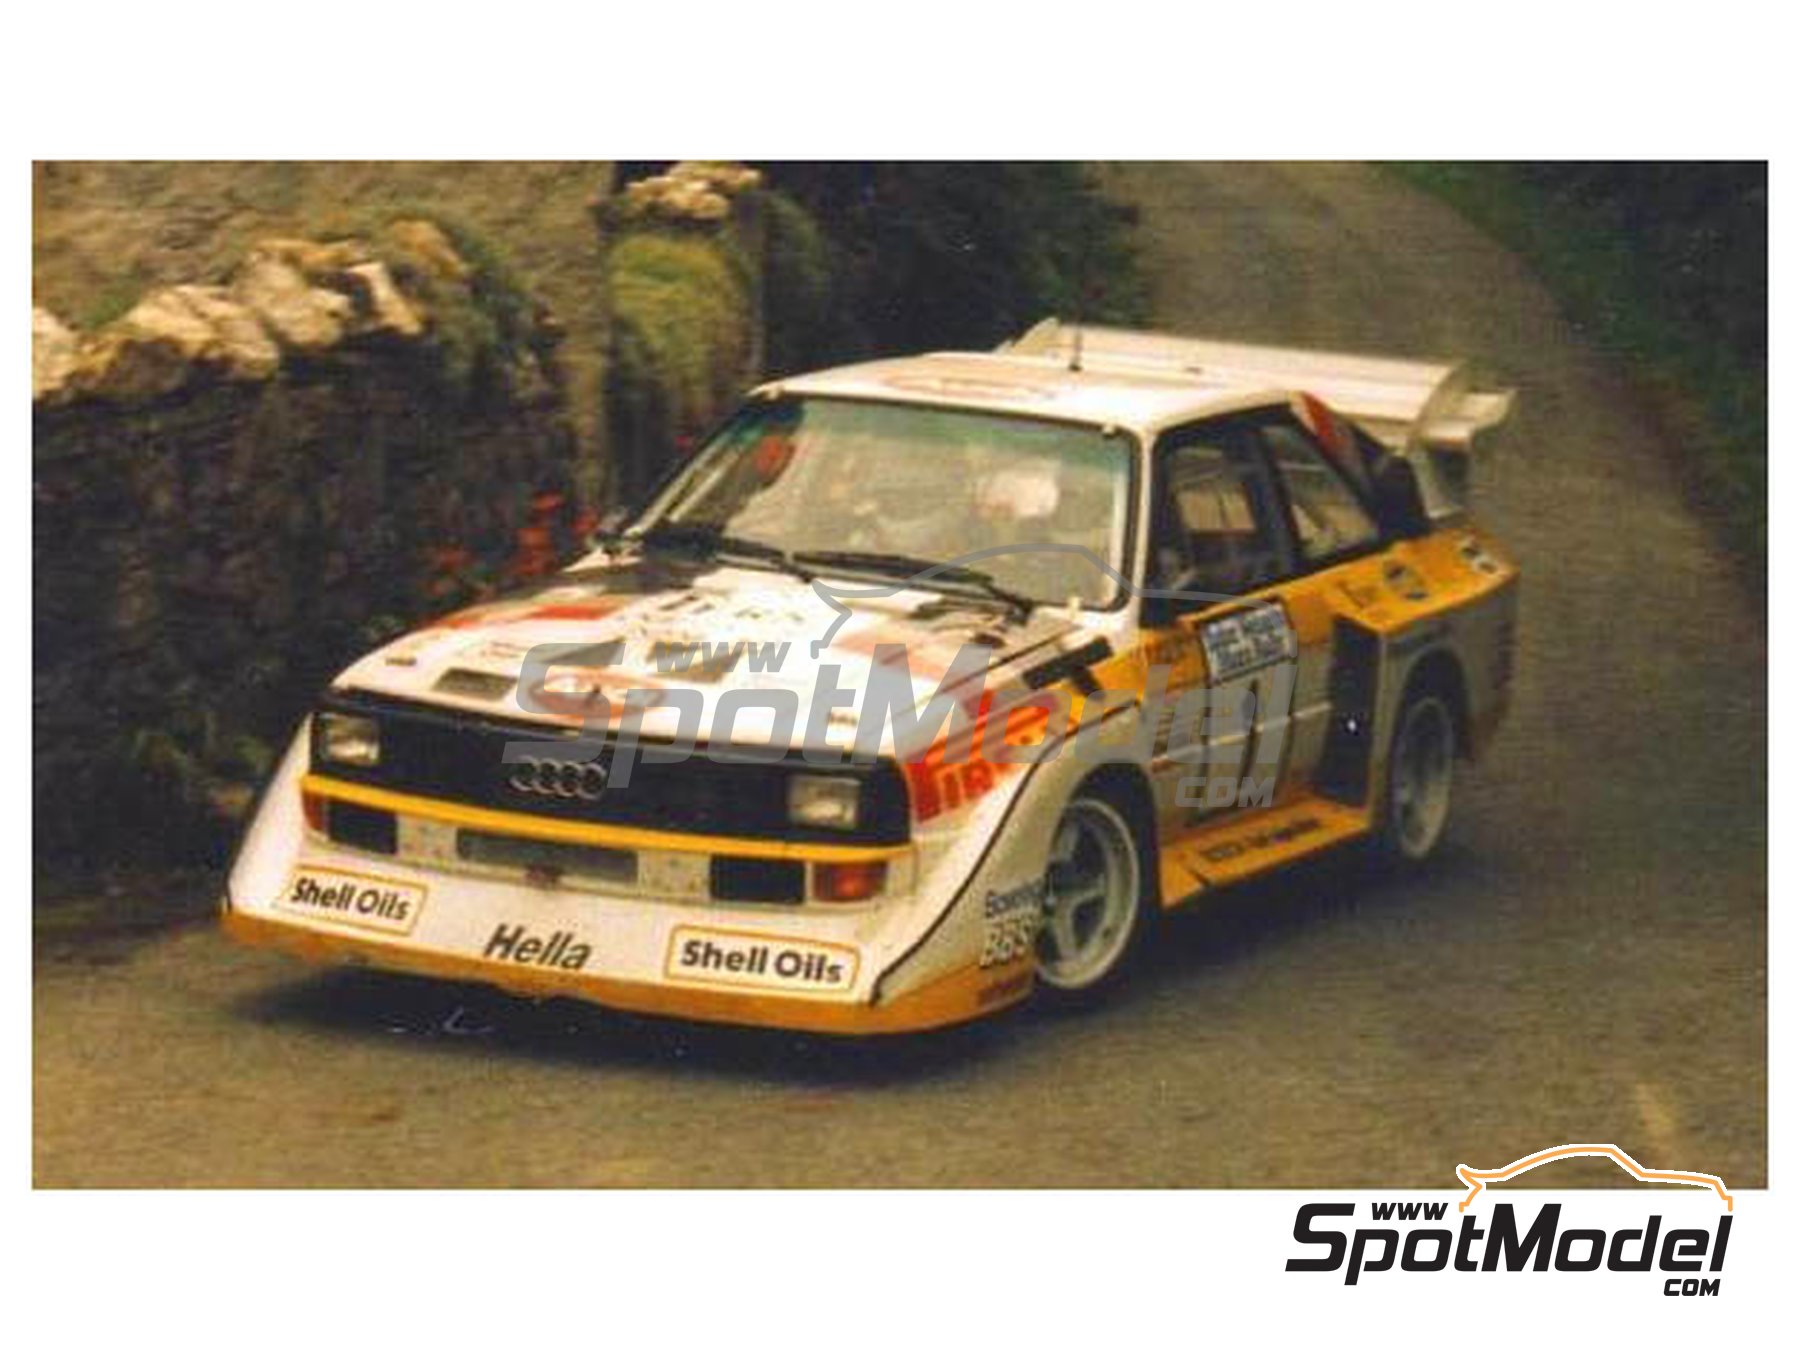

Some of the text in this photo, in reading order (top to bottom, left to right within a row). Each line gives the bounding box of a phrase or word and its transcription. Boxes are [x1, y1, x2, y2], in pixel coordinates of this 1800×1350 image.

[290, 877, 411, 921] Shell Oils
[482, 922, 594, 971] Hella
[680, 939, 844, 984] Shell Oils
